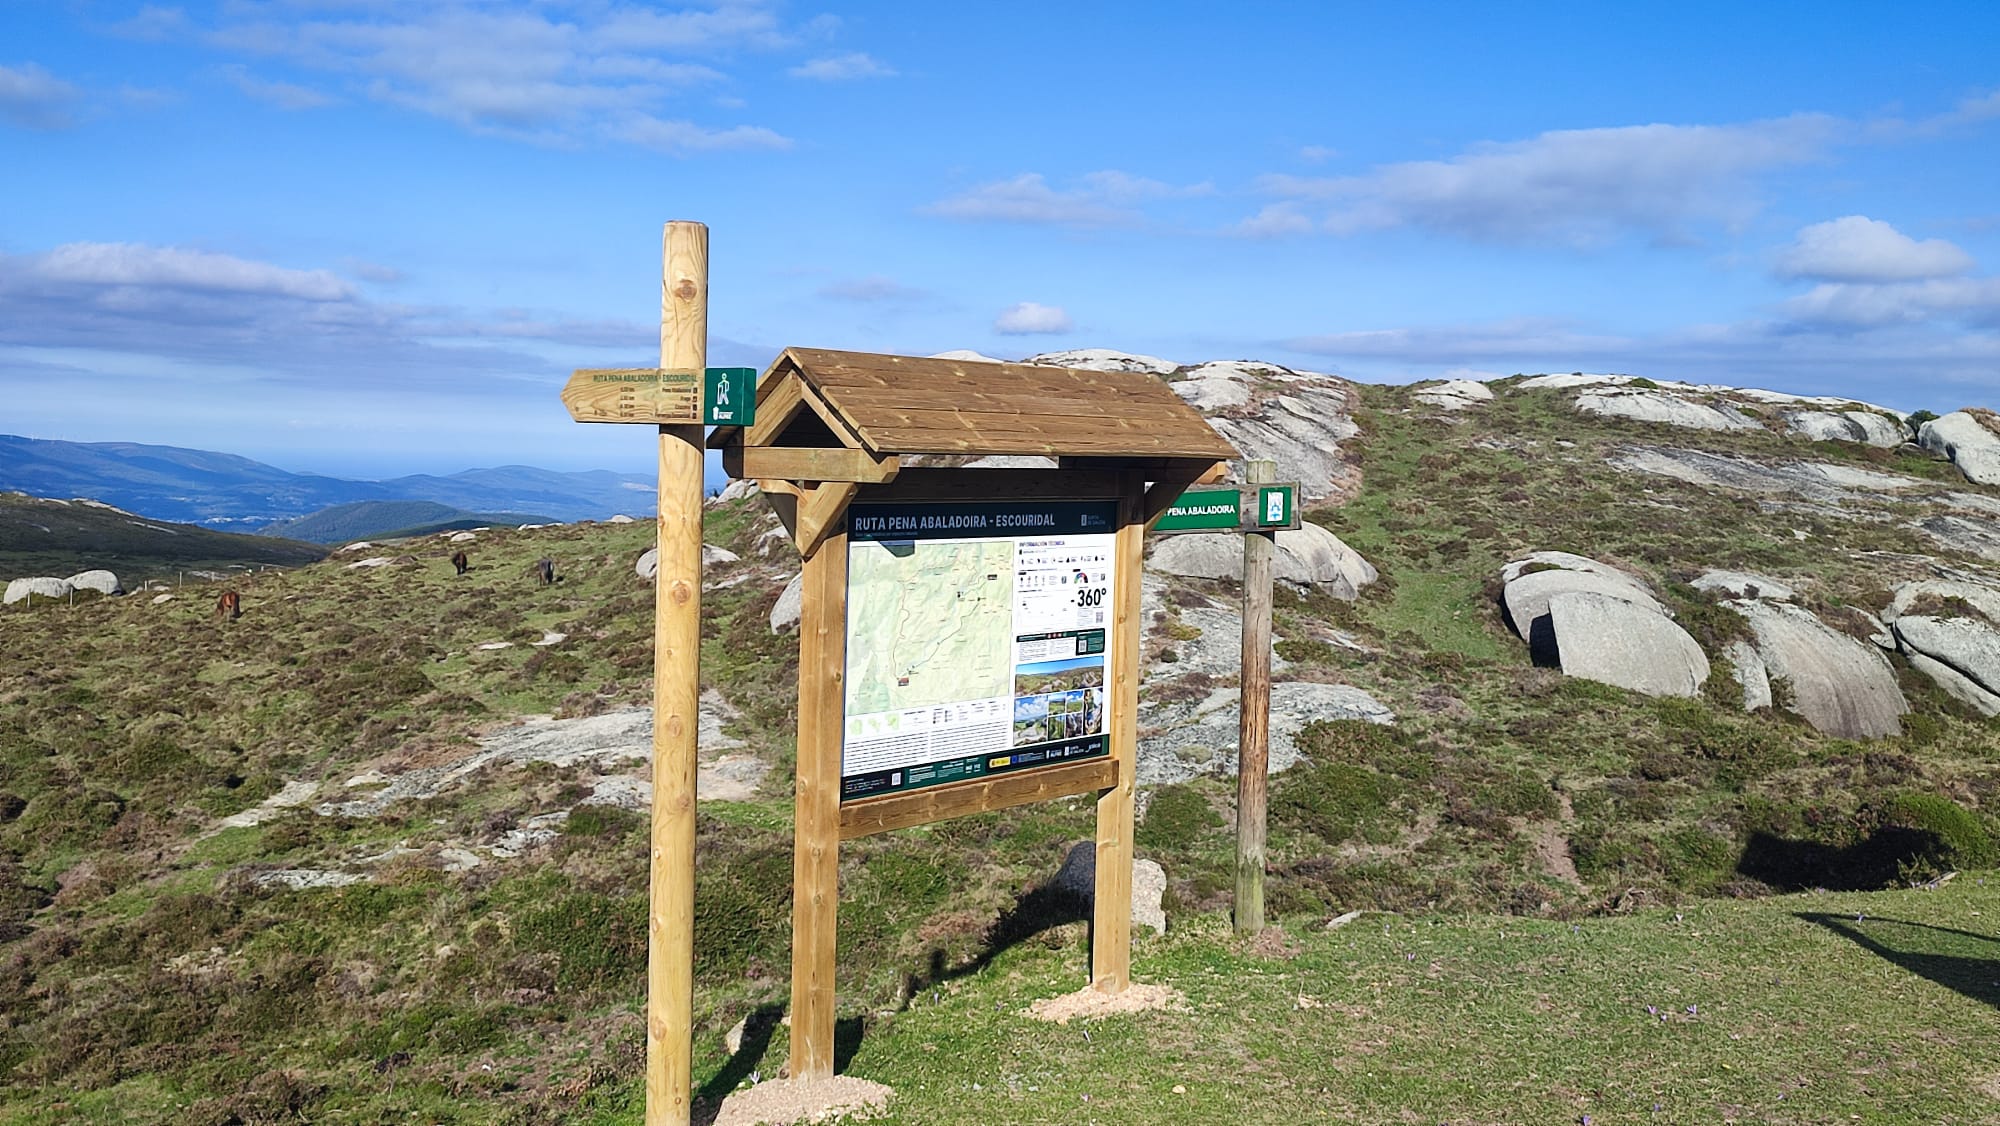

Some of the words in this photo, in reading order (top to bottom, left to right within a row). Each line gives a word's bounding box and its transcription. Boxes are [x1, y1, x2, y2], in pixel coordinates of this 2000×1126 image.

[1188, 504, 1236, 516] ABALADOIRA
[855, 517, 886, 531] RUTA
[888, 516, 917, 530] PENA
[920, 515, 987, 529] ABALADOIRA
[995, 514, 1055, 527] ESCOURIDAL
